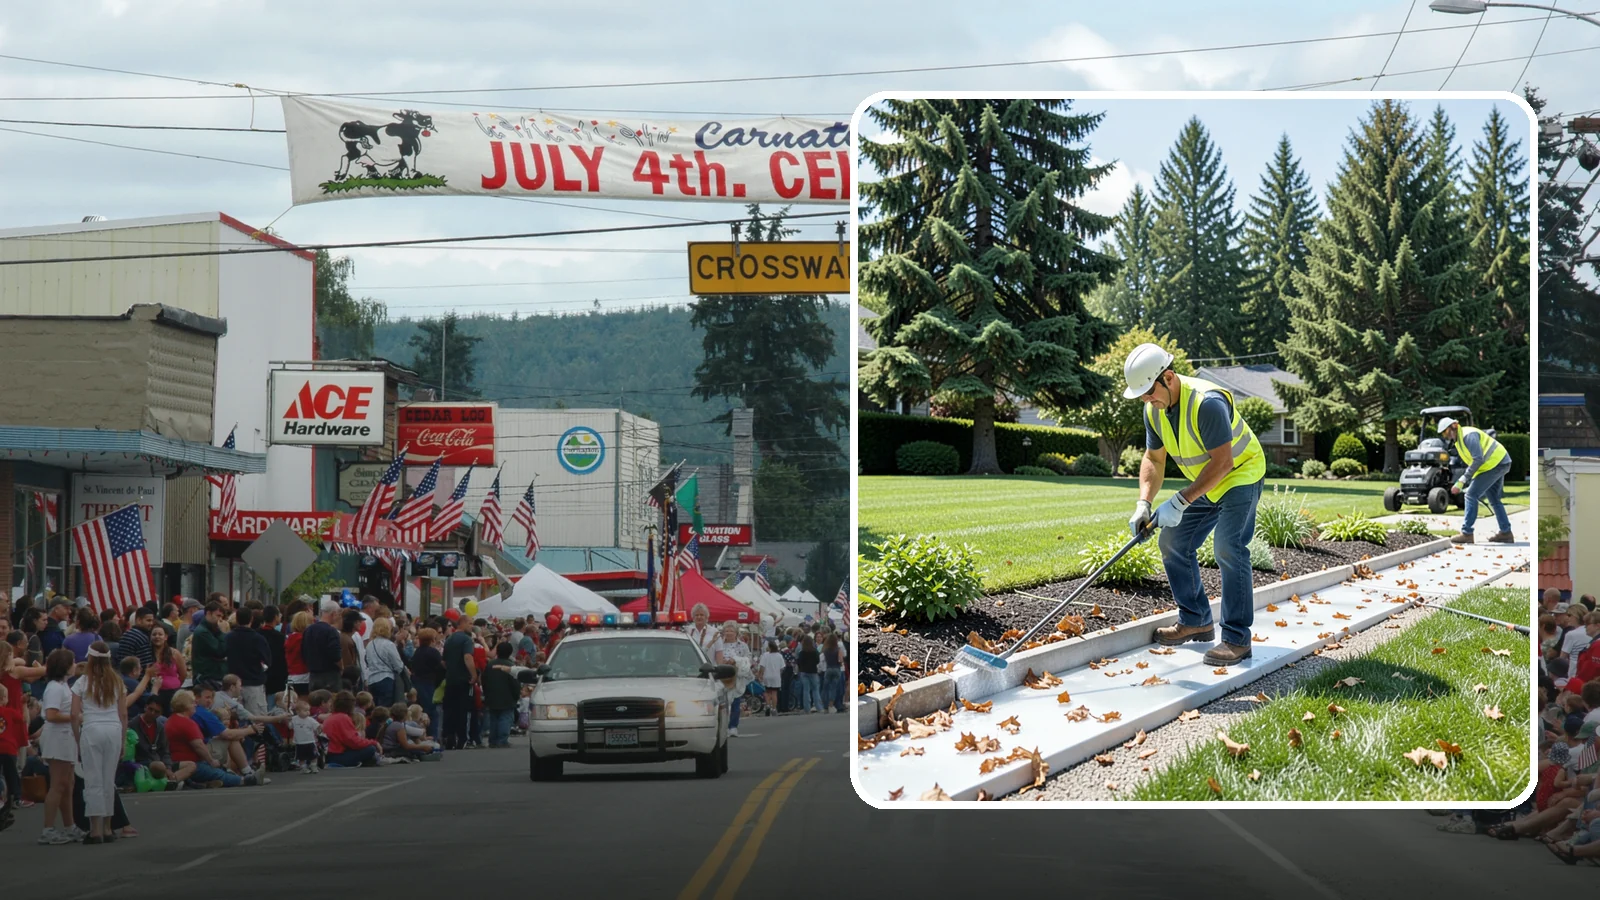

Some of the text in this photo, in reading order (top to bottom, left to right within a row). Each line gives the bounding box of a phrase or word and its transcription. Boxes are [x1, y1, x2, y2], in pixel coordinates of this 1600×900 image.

[481, 141, 604, 192] JULY
[632, 150, 746, 198] 4th.
[697, 254, 850, 280] CROSSWA
[283, 380, 373, 420] ACE
[405, 409, 453, 422] CEDAR
[284, 421, 371, 436] Hardware
[353, 467, 385, 480] Simpl
[83, 484, 155, 495] St. Vincent de Paul
[688, 526, 741, 535] CRNATION
[699, 535, 730, 543] GLASS
